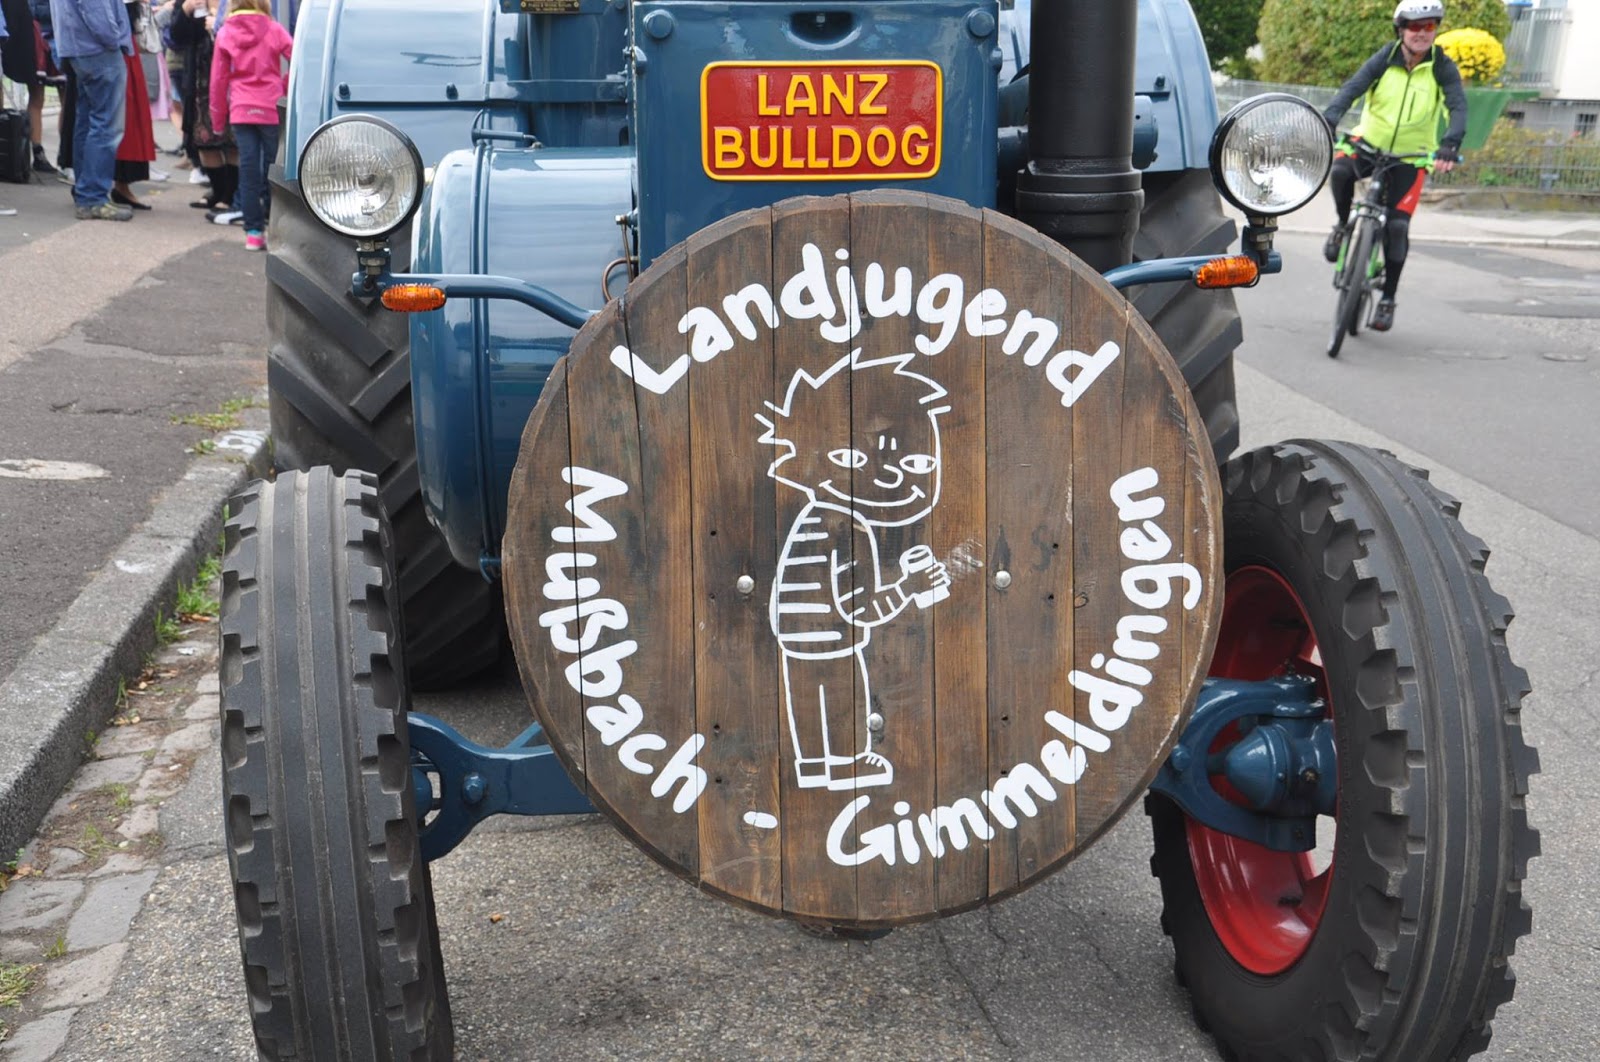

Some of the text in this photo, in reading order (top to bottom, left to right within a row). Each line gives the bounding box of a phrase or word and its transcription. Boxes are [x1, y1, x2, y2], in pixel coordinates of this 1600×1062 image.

[757, 74, 889, 116] LANZ
[714, 126, 930, 169] BULLDOG
[609, 242, 1121, 408] Landjugend
[538, 466, 708, 814] Mußbach
[825, 466, 1203, 867] Gimmeldingen
